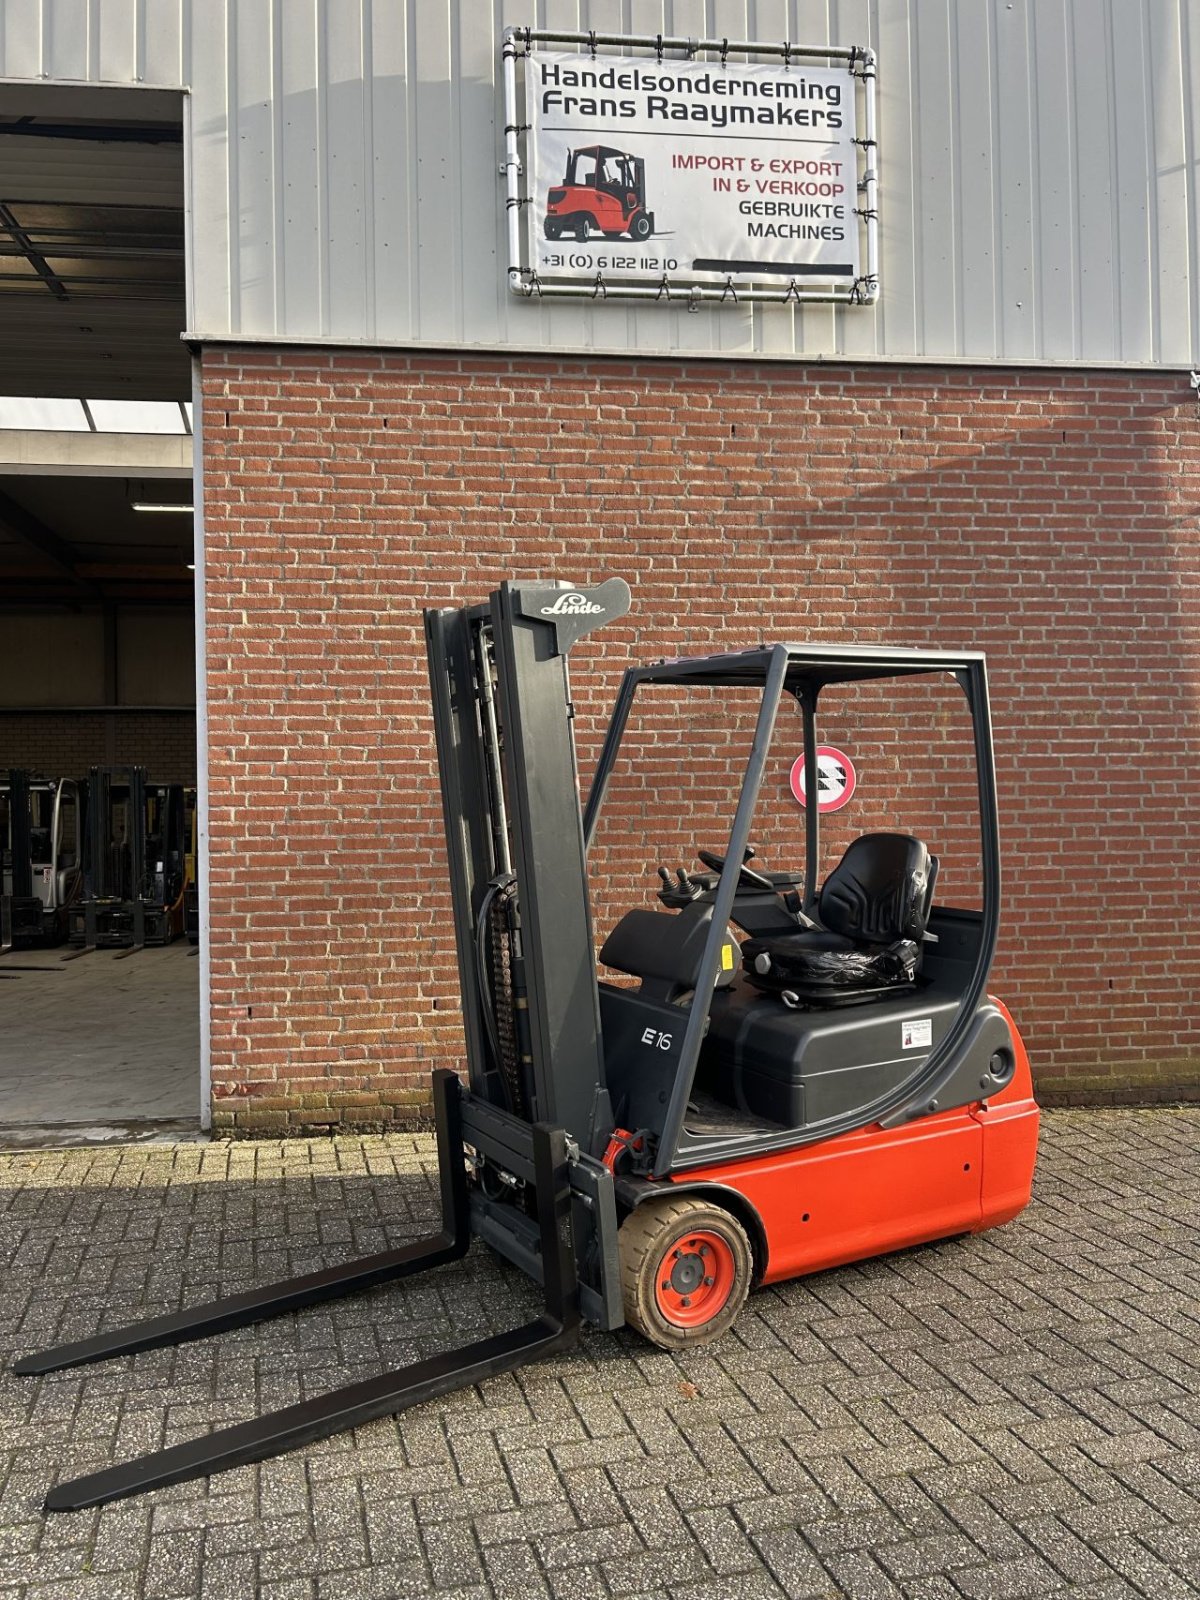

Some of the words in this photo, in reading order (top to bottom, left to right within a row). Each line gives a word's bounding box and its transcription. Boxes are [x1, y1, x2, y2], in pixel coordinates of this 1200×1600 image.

[541, 64, 841, 106] Handelsonderneming
[543, 90, 636, 118] Frans
[647, 96, 843, 128] Raaymakers
[672, 154, 745, 171] IMPORT
[751, 158, 764, 172] &
[769, 159, 843, 176] EXPORT
[713, 177, 731, 192] IN
[737, 179, 750, 193] &
[755, 180, 844, 197] VERKOOP
[739, 201, 844, 219] GEBRUIKTE
[748, 223, 845, 241] MACHINES
[542, 255, 564, 267] +31
[569, 254, 593, 269] (0)
[597, 257, 607, 268] 6
[612, 257, 636, 269] 122
[640, 257, 659, 270] 112
[663, 259, 678, 270] 10
[541, 593, 605, 615] Linde
